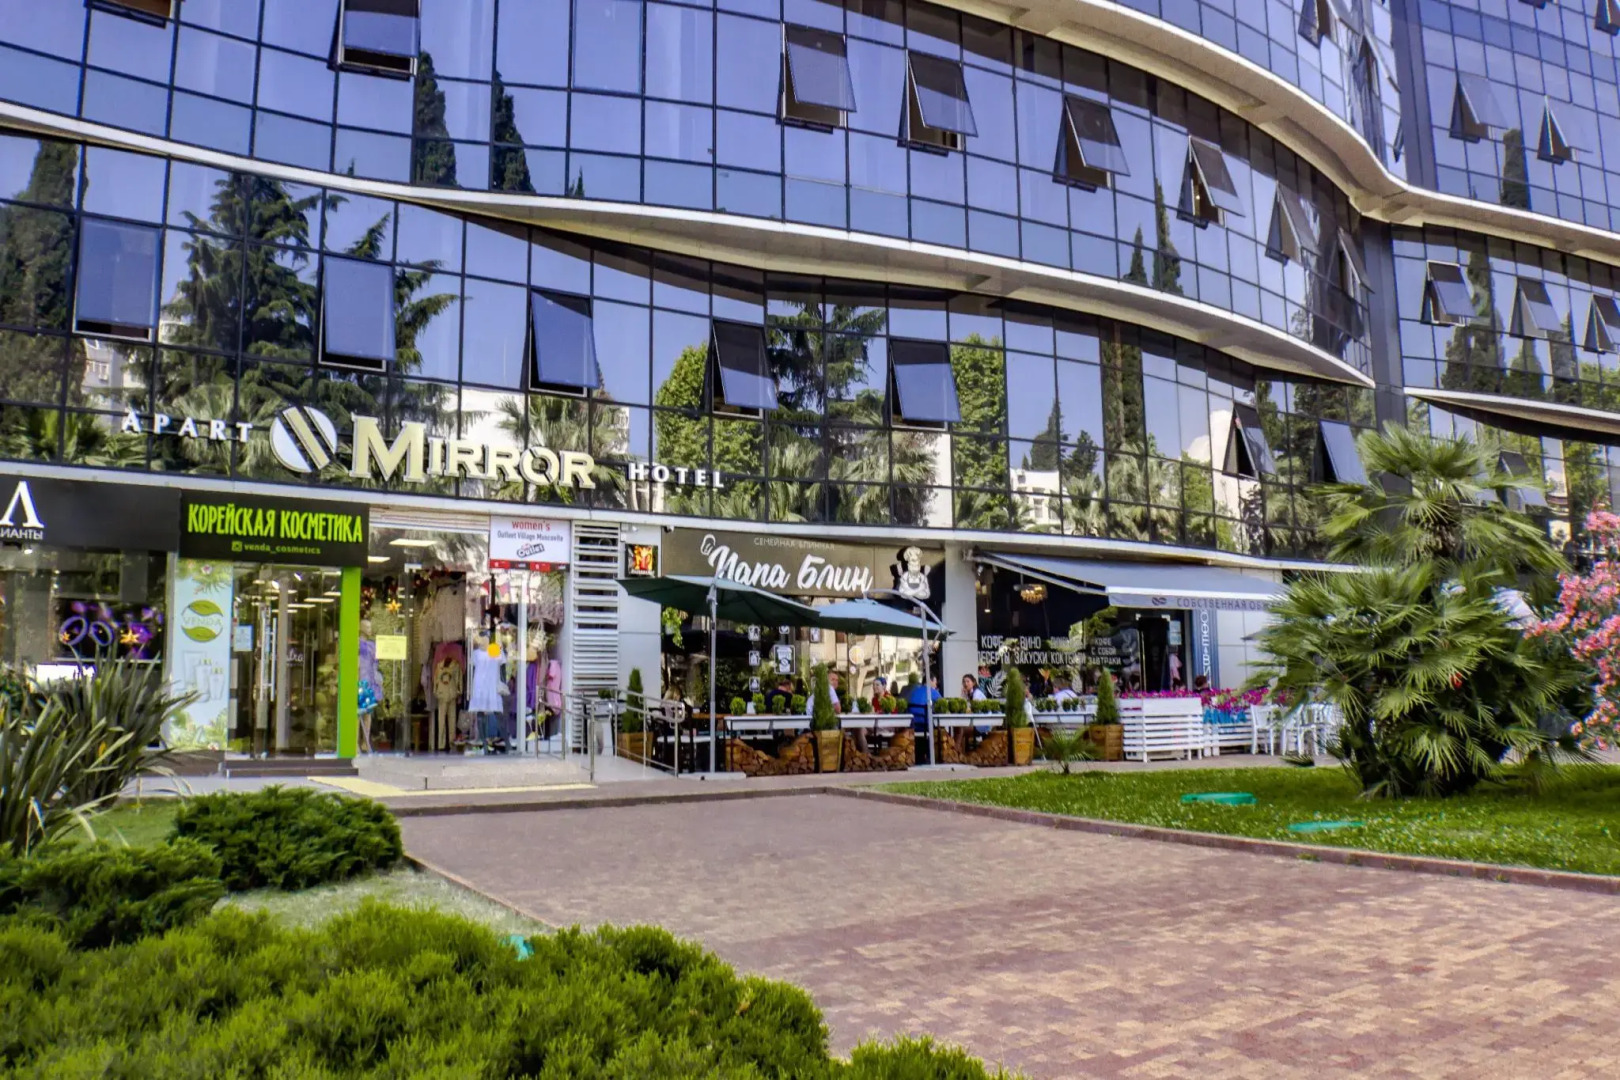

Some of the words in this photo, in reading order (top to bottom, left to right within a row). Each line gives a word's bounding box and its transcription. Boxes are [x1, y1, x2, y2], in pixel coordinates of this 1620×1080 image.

[121, 408, 253, 443] APART
[350, 413, 596, 488] MIRROR
[628, 462, 725, 488] HOTEL
[187, 503, 277, 537] КОРЕЙСКАЯ
[279, 509, 363, 543] КОСМЕТИКА
[512, 520, 551, 532] women's
[0, 527, 43, 540] ИАНТЫ
[244, 542, 321, 554] venda_cosmetics
[753, 537, 794, 547] СЕМЕЙНАЯ
[708, 545, 791, 590] Папа
[797, 554, 873, 592] Блин
[1177, 597, 1247, 610] СОБСТВЕННАЯ
[1200, 608, 1210, 646] ОФЕ
[981, 635, 1004, 649] КОФЕ
[1019, 636, 1041, 650] ВИНО
[1014, 651, 1048, 665] ЗАКУСКИ
